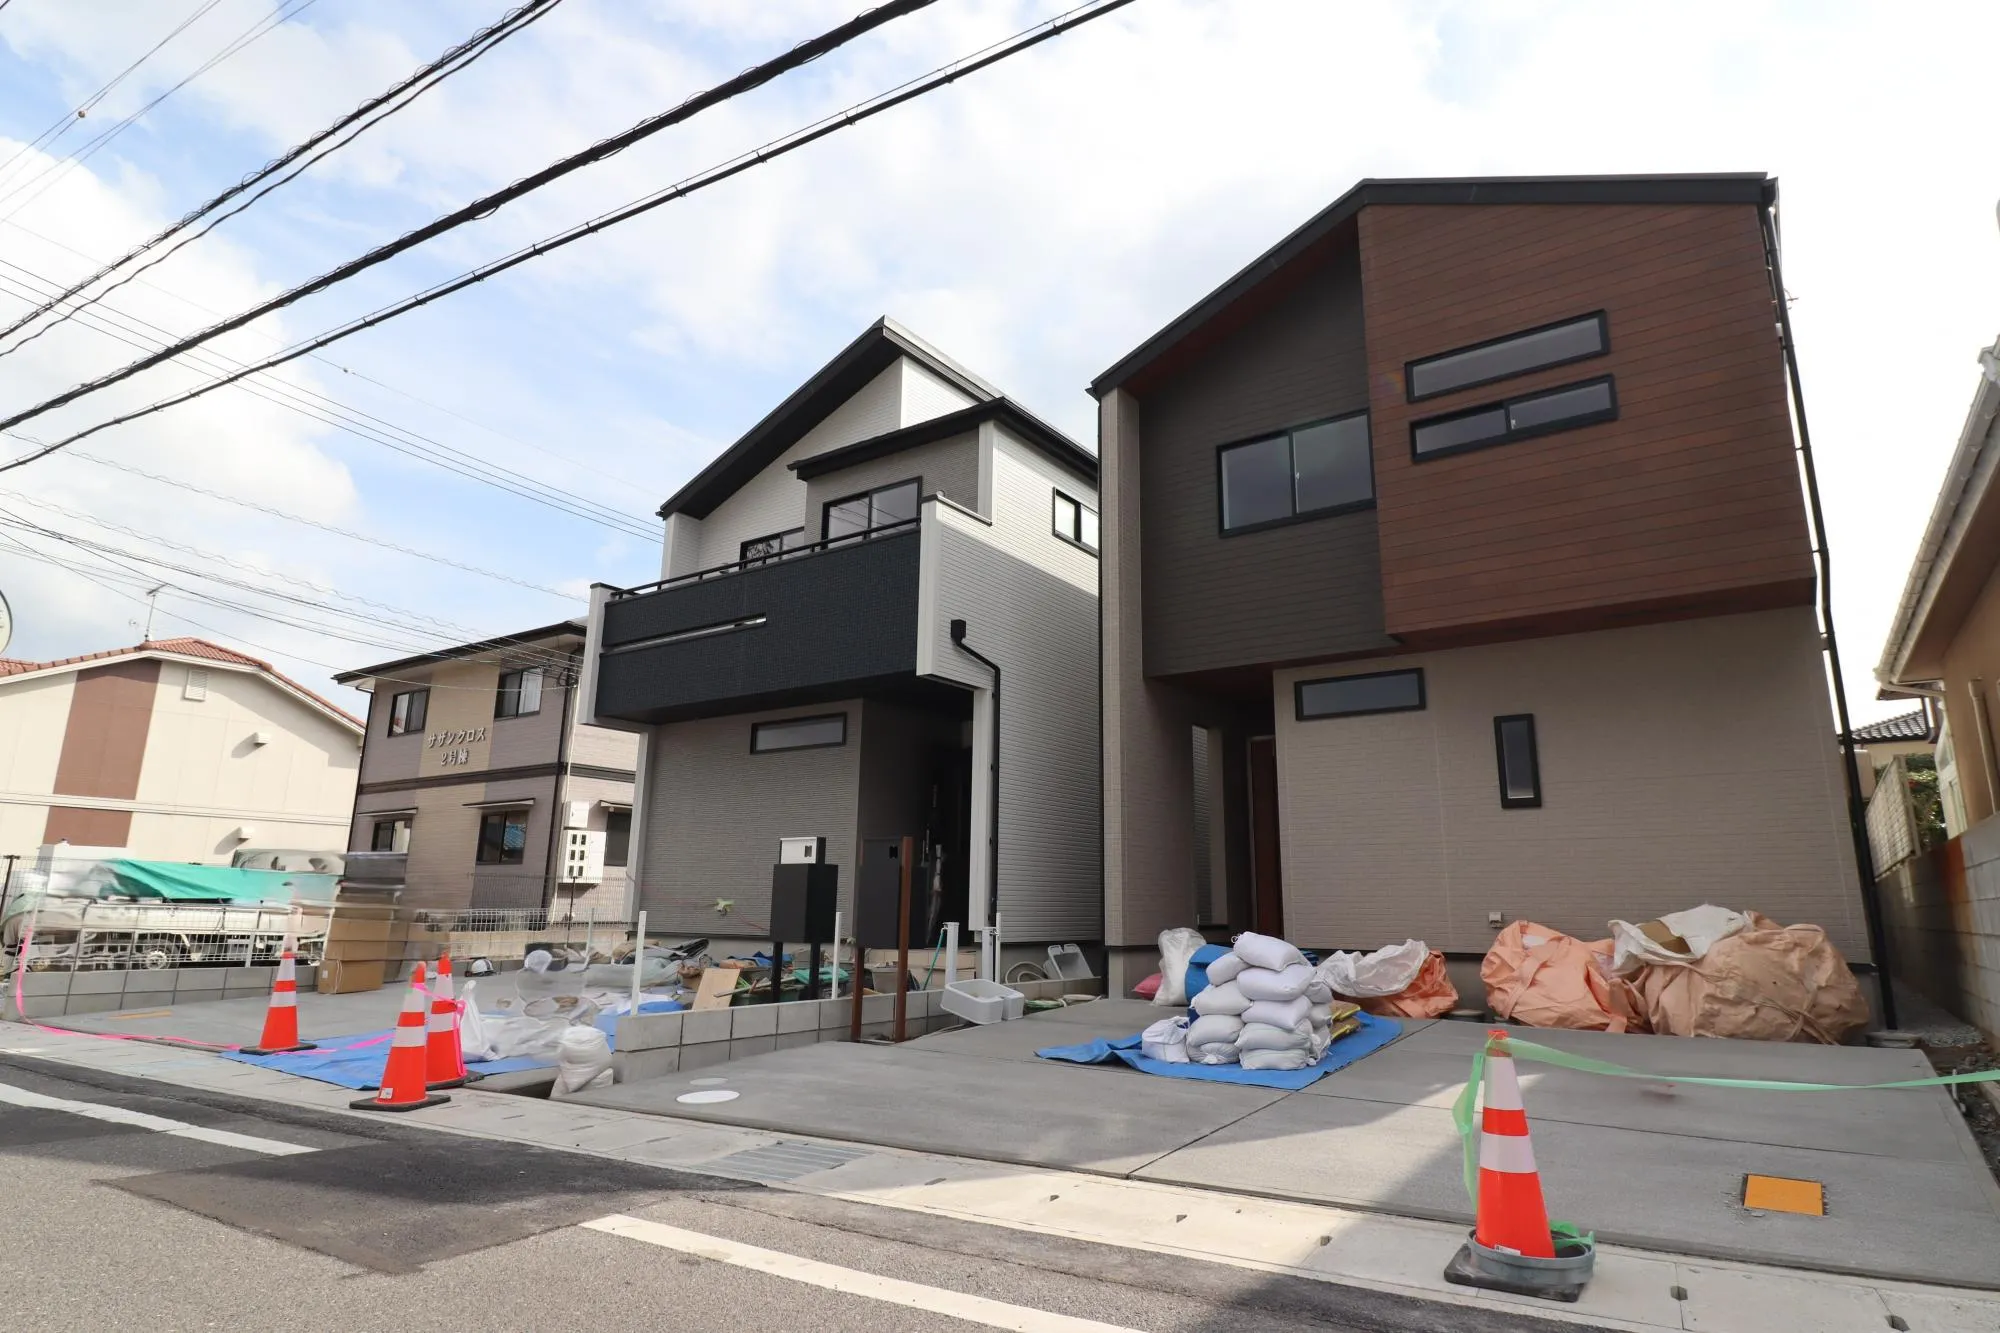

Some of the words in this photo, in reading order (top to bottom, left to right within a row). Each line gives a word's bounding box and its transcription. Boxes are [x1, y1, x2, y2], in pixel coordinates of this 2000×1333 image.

[428, 727, 486, 748] サザンクロス
